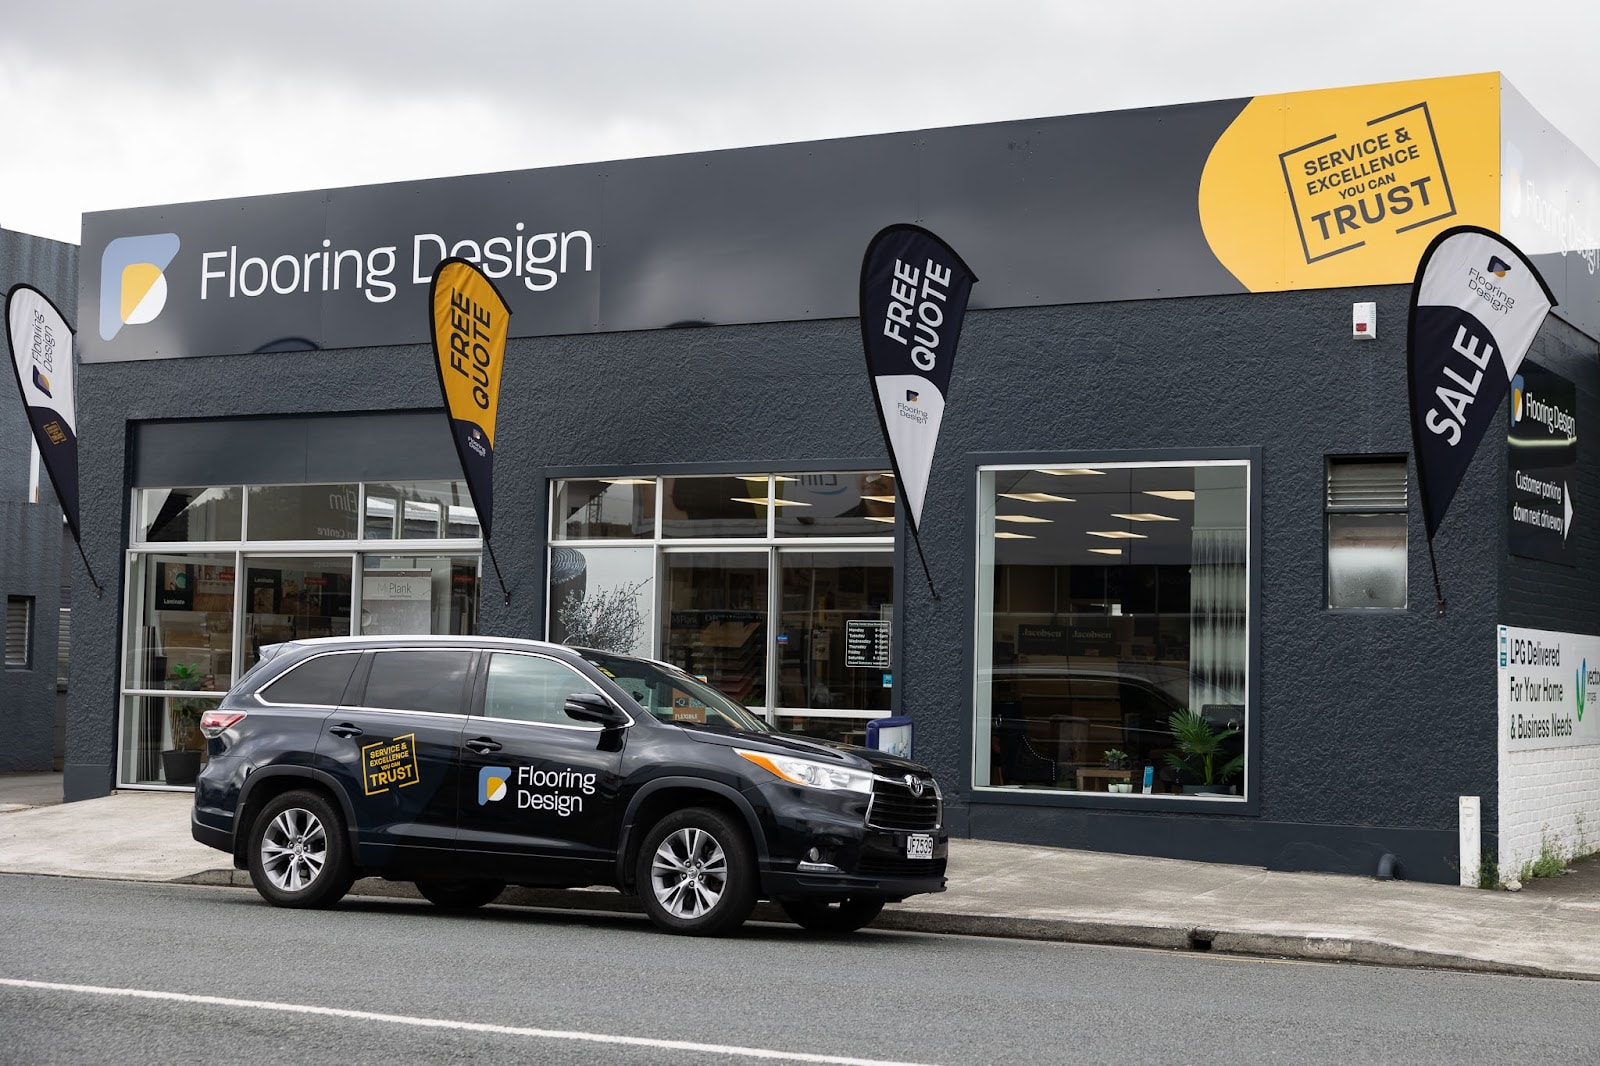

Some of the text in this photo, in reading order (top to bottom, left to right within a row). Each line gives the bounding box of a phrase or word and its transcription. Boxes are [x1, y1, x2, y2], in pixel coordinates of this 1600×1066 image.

[1304, 126, 1413, 176] SERVICE &
[1306, 144, 1420, 196] EXCELLENCE
[1338, 172, 1396, 200] YOU CAN
[1311, 176, 1432, 240] TRUST
[200, 222, 592, 303] Flooring Design
[883, 257, 920, 345] FREE
[1468, 267, 1516, 309] Flooring
[1468, 278, 1510, 315] Design
[910, 257, 952, 372] QUOTE
[31, 308, 46, 365] Flooring
[43, 325, 56, 373] Design
[450, 287, 472, 378] FREE
[472, 302, 492, 410] QUOTE
[1425, 324, 1494, 447] SALE
[897, 402, 928, 418] Flooring
[899, 409, 929, 425] Design
[1525, 392, 1576, 440] Flooring Design
[1515, 469, 1562, 504] Customer parking
[1512, 502, 1564, 535] down next driveway
[1510, 638, 1560, 666] LPG Delivered
[1510, 676, 1523, 702] For
[1524, 677, 1541, 702] Your
[1543, 678, 1563, 702] Home
[1510, 713, 1573, 740] & Business Needs
[369, 742, 408, 759] SERVICE &
[369, 751, 409, 767] EXCELLENCE
[381, 761, 401, 771] YOU CAN
[369, 764, 412, 787] TRUST
[518, 765, 596, 795] Flooring
[517, 790, 583, 817] Design
[907, 838, 932, 854] JFZ539
